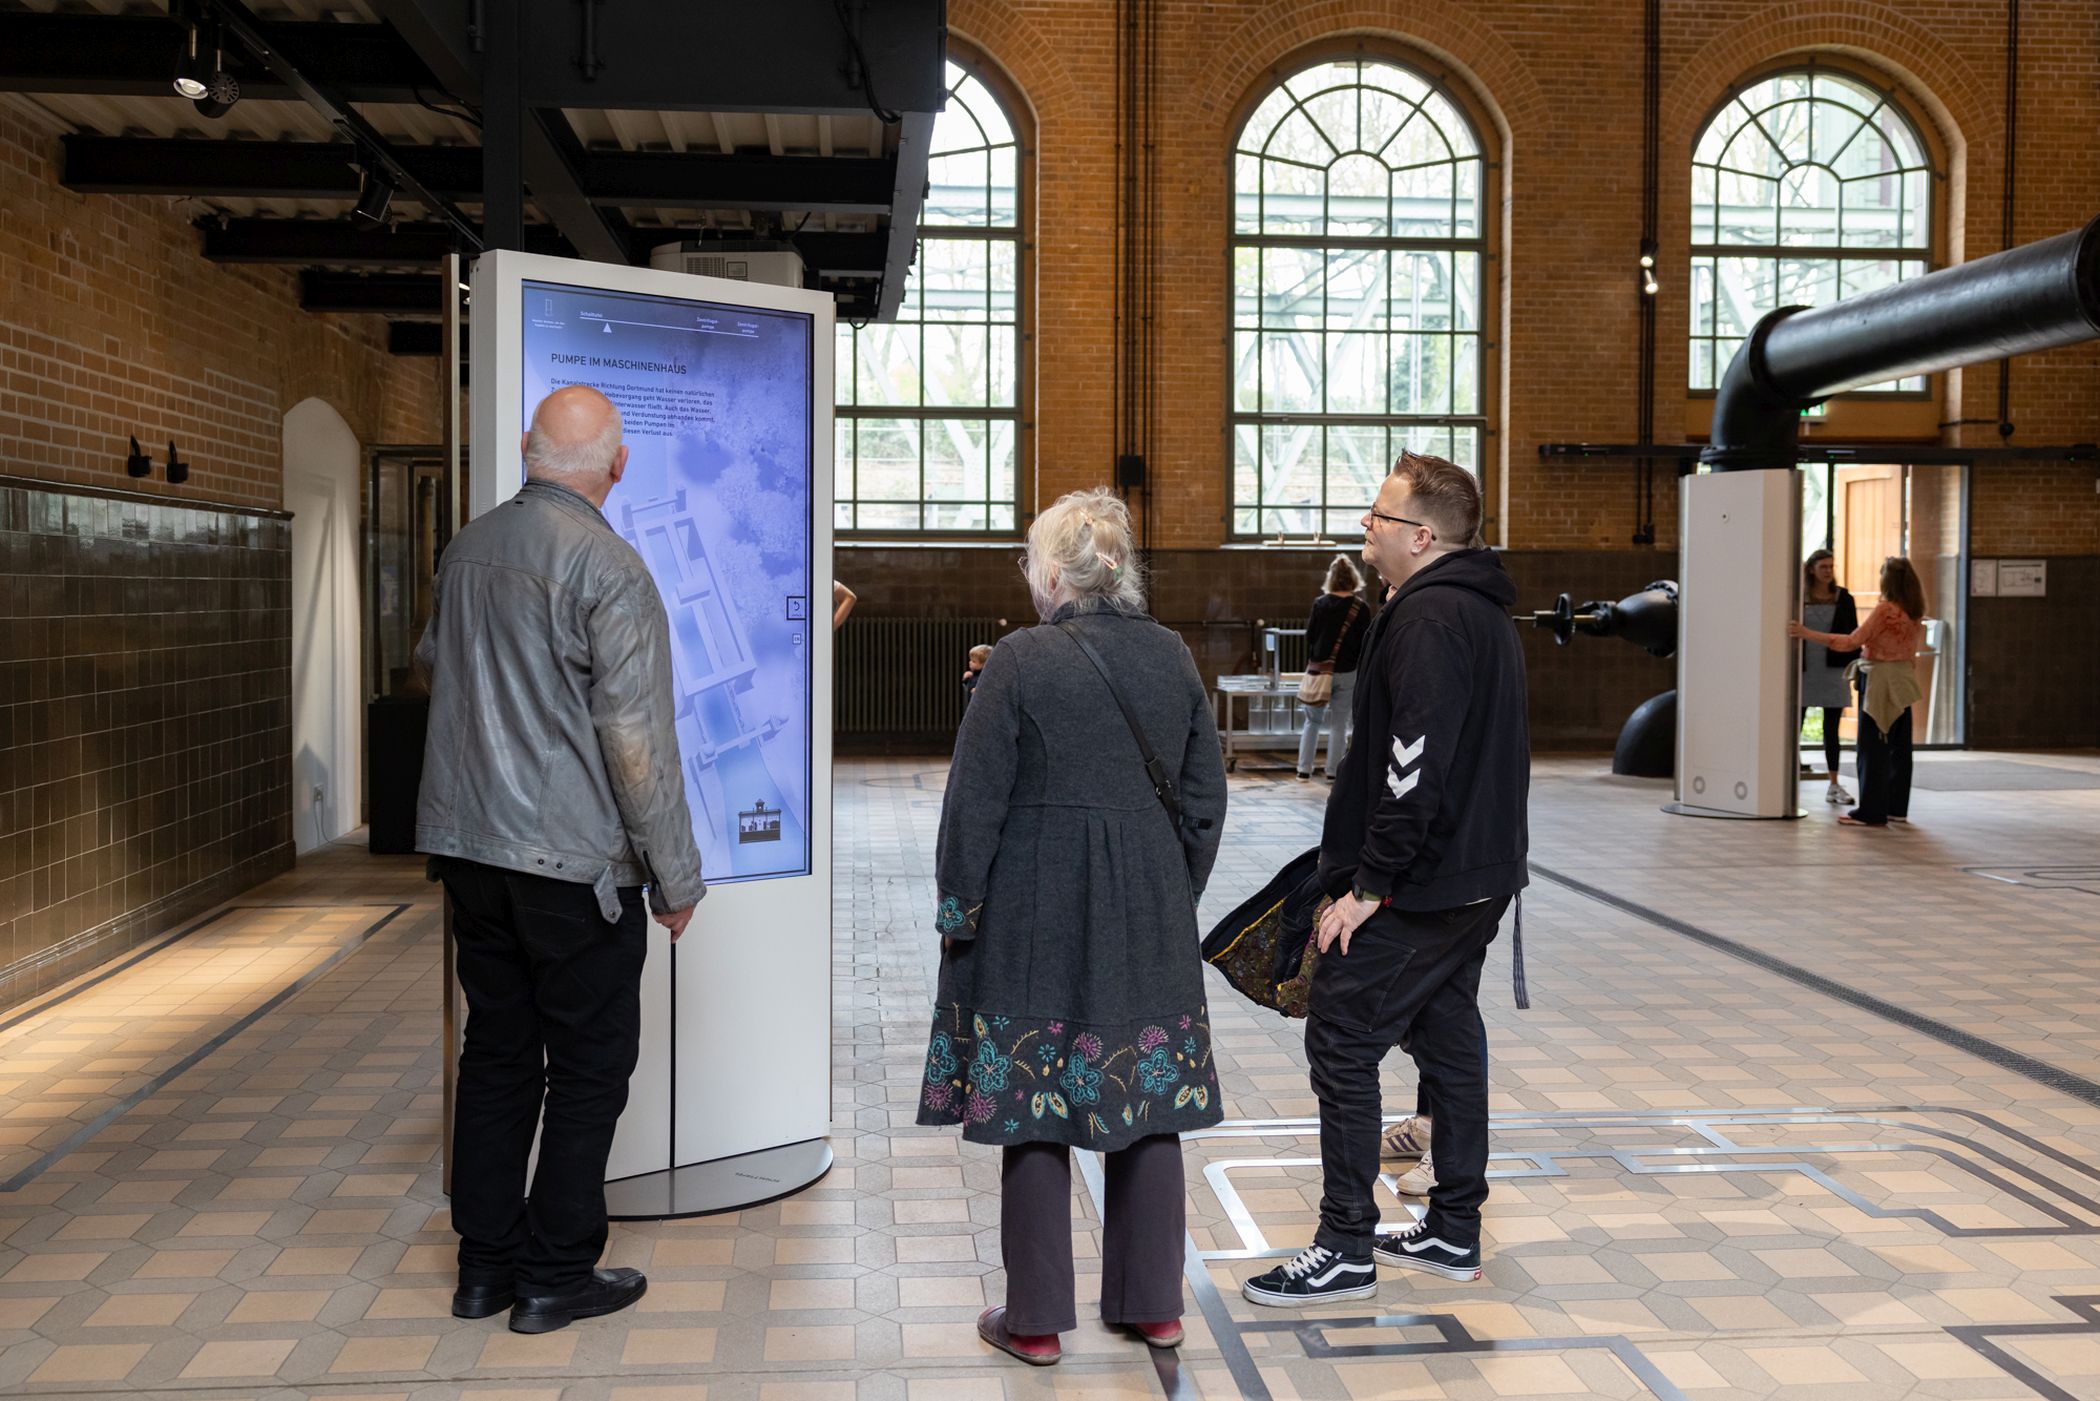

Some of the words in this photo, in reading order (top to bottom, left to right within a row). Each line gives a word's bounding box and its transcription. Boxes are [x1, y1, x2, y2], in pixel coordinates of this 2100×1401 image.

[552, 354, 586, 365] PUMPE
[590, 357, 600, 366] IM
[604, 359, 687, 374] MASCHINENHAUS
[601, 382, 625, 391] Richtung
[605, 392, 641, 401] Hebevorgang
[632, 411, 666, 420] Verdunstung
